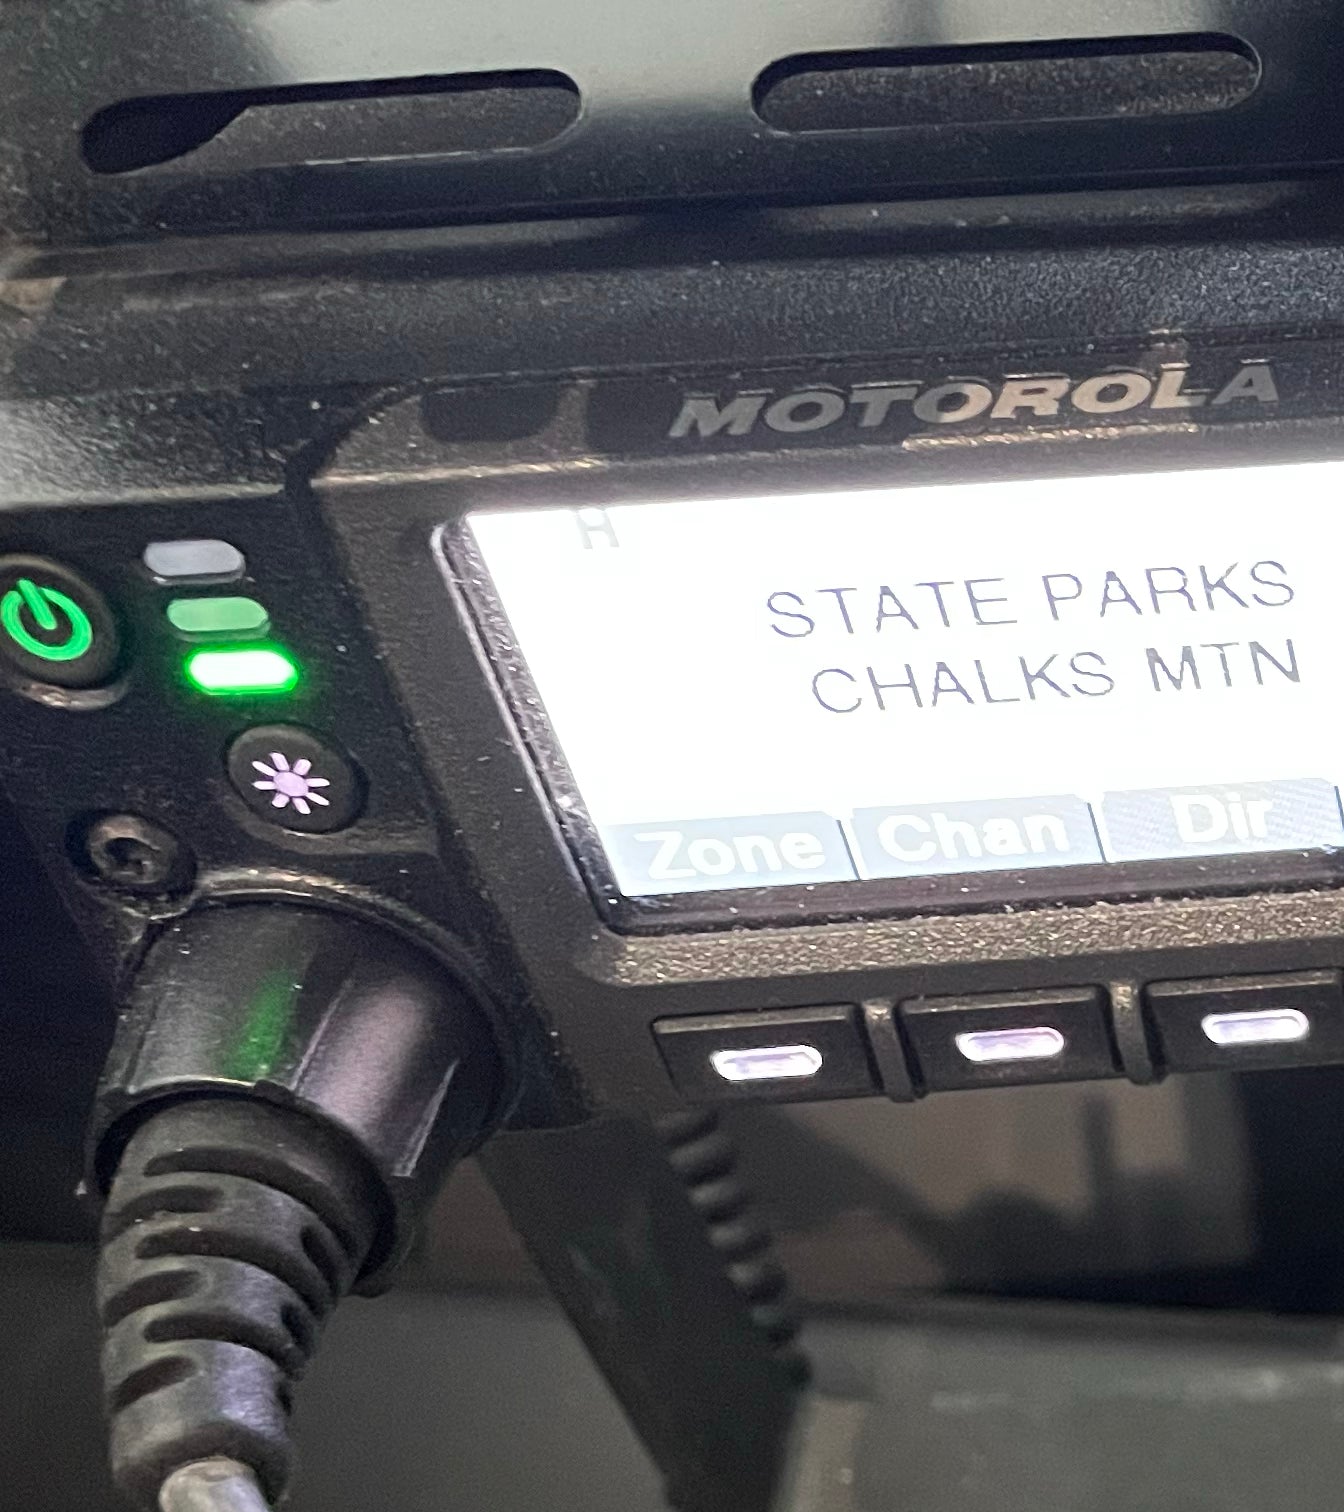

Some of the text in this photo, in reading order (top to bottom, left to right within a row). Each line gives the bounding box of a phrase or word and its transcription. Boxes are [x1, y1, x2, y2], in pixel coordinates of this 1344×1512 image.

[668, 359, 1280, 439] MOTOROLA
[765, 560, 1297, 641] STATE PARKS
[809, 639, 1303, 715] CHALKS MTN
[877, 806, 1070, 864] Chan
[1174, 790, 1273, 845] Dir
[640, 826, 826, 882] Zone
